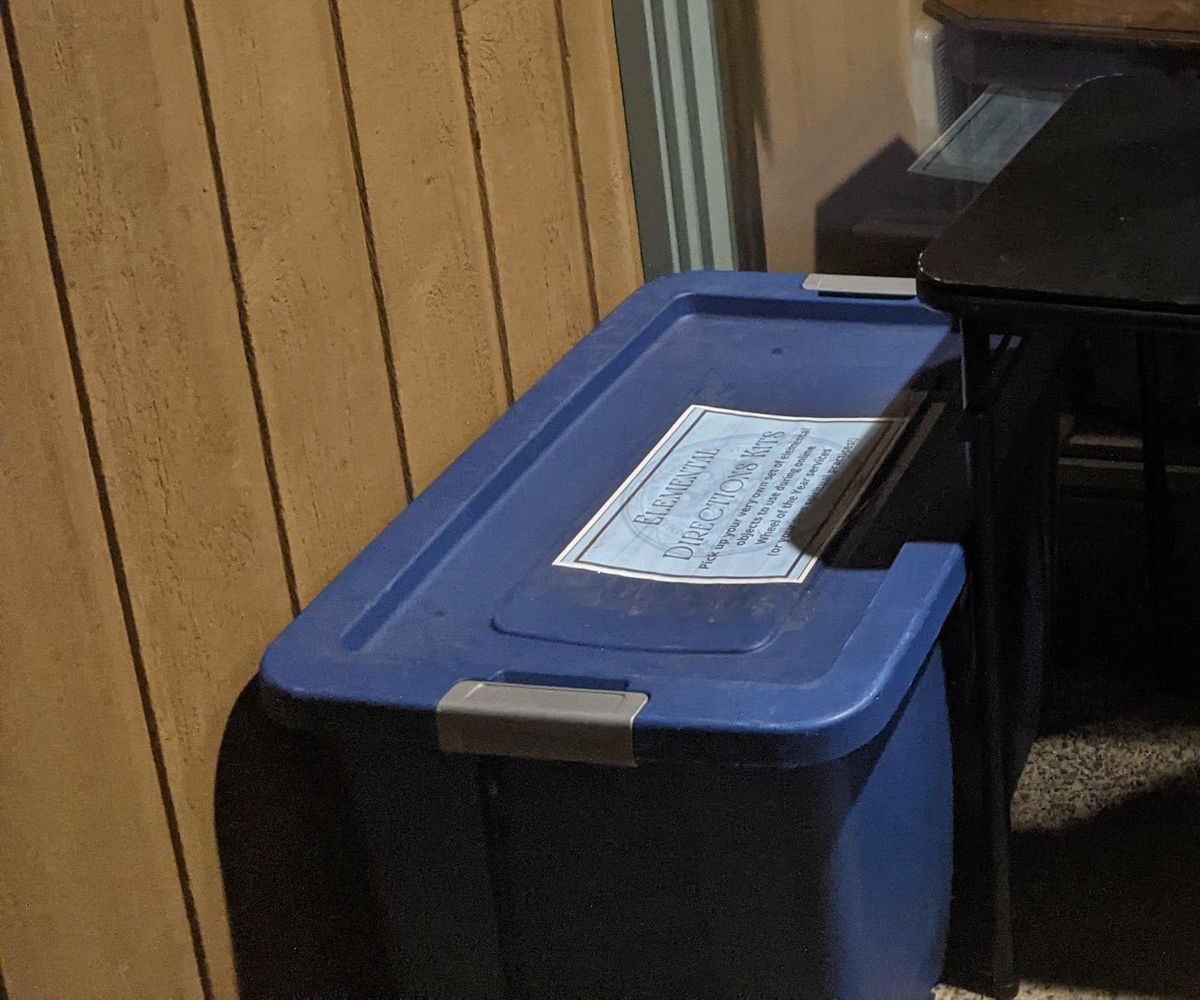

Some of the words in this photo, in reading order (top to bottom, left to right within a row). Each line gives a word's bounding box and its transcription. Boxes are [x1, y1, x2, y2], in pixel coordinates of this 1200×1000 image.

[632, 448, 720, 525] ELEMENTAL
[662, 462, 758, 560] DIRECTIONS
[740, 431, 785, 457] KITS
[697, 551, 719, 569] Pick
[721, 519, 741, 537] your
[737, 499, 758, 516] very
[751, 481, 769, 497] own
[764, 469, 779, 480] set
[736, 517, 763, 545] objects
[764, 492, 781, 505] use
[774, 468, 801, 490] during
[794, 445, 816, 466] online
[754, 519, 781, 544] Wheel
[781, 496, 798, 508] the
[790, 477, 810, 493] Year
[806, 448, 831, 476] services
